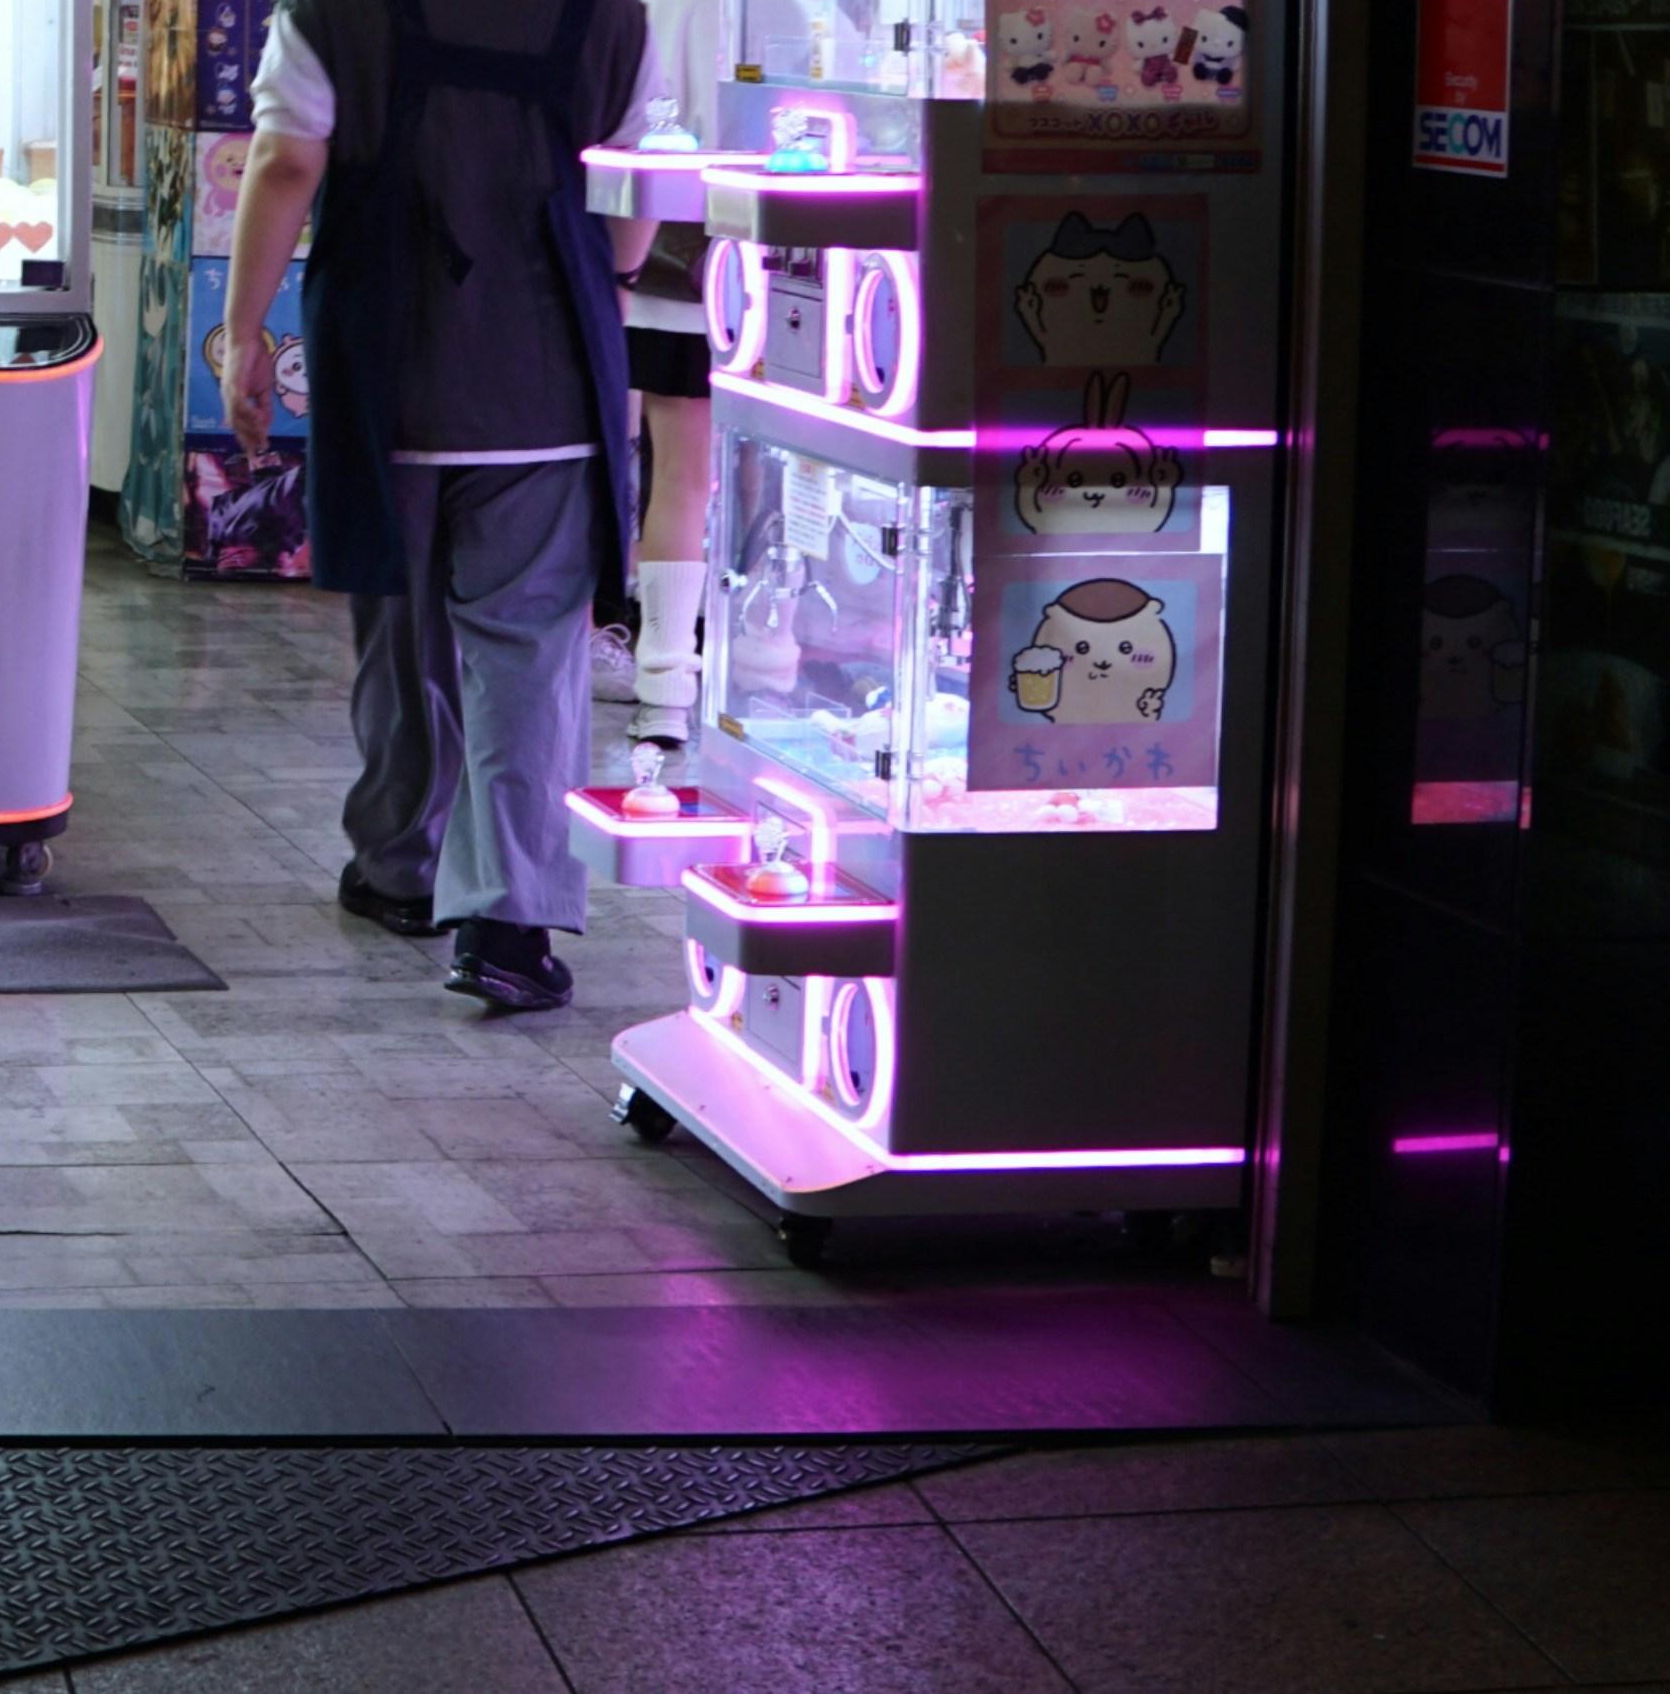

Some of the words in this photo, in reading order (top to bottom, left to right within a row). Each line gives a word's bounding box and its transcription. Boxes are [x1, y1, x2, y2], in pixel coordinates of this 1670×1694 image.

[1420, 112, 1502, 158] SECOM
[1014, 743, 1174, 783] ちいかわ
